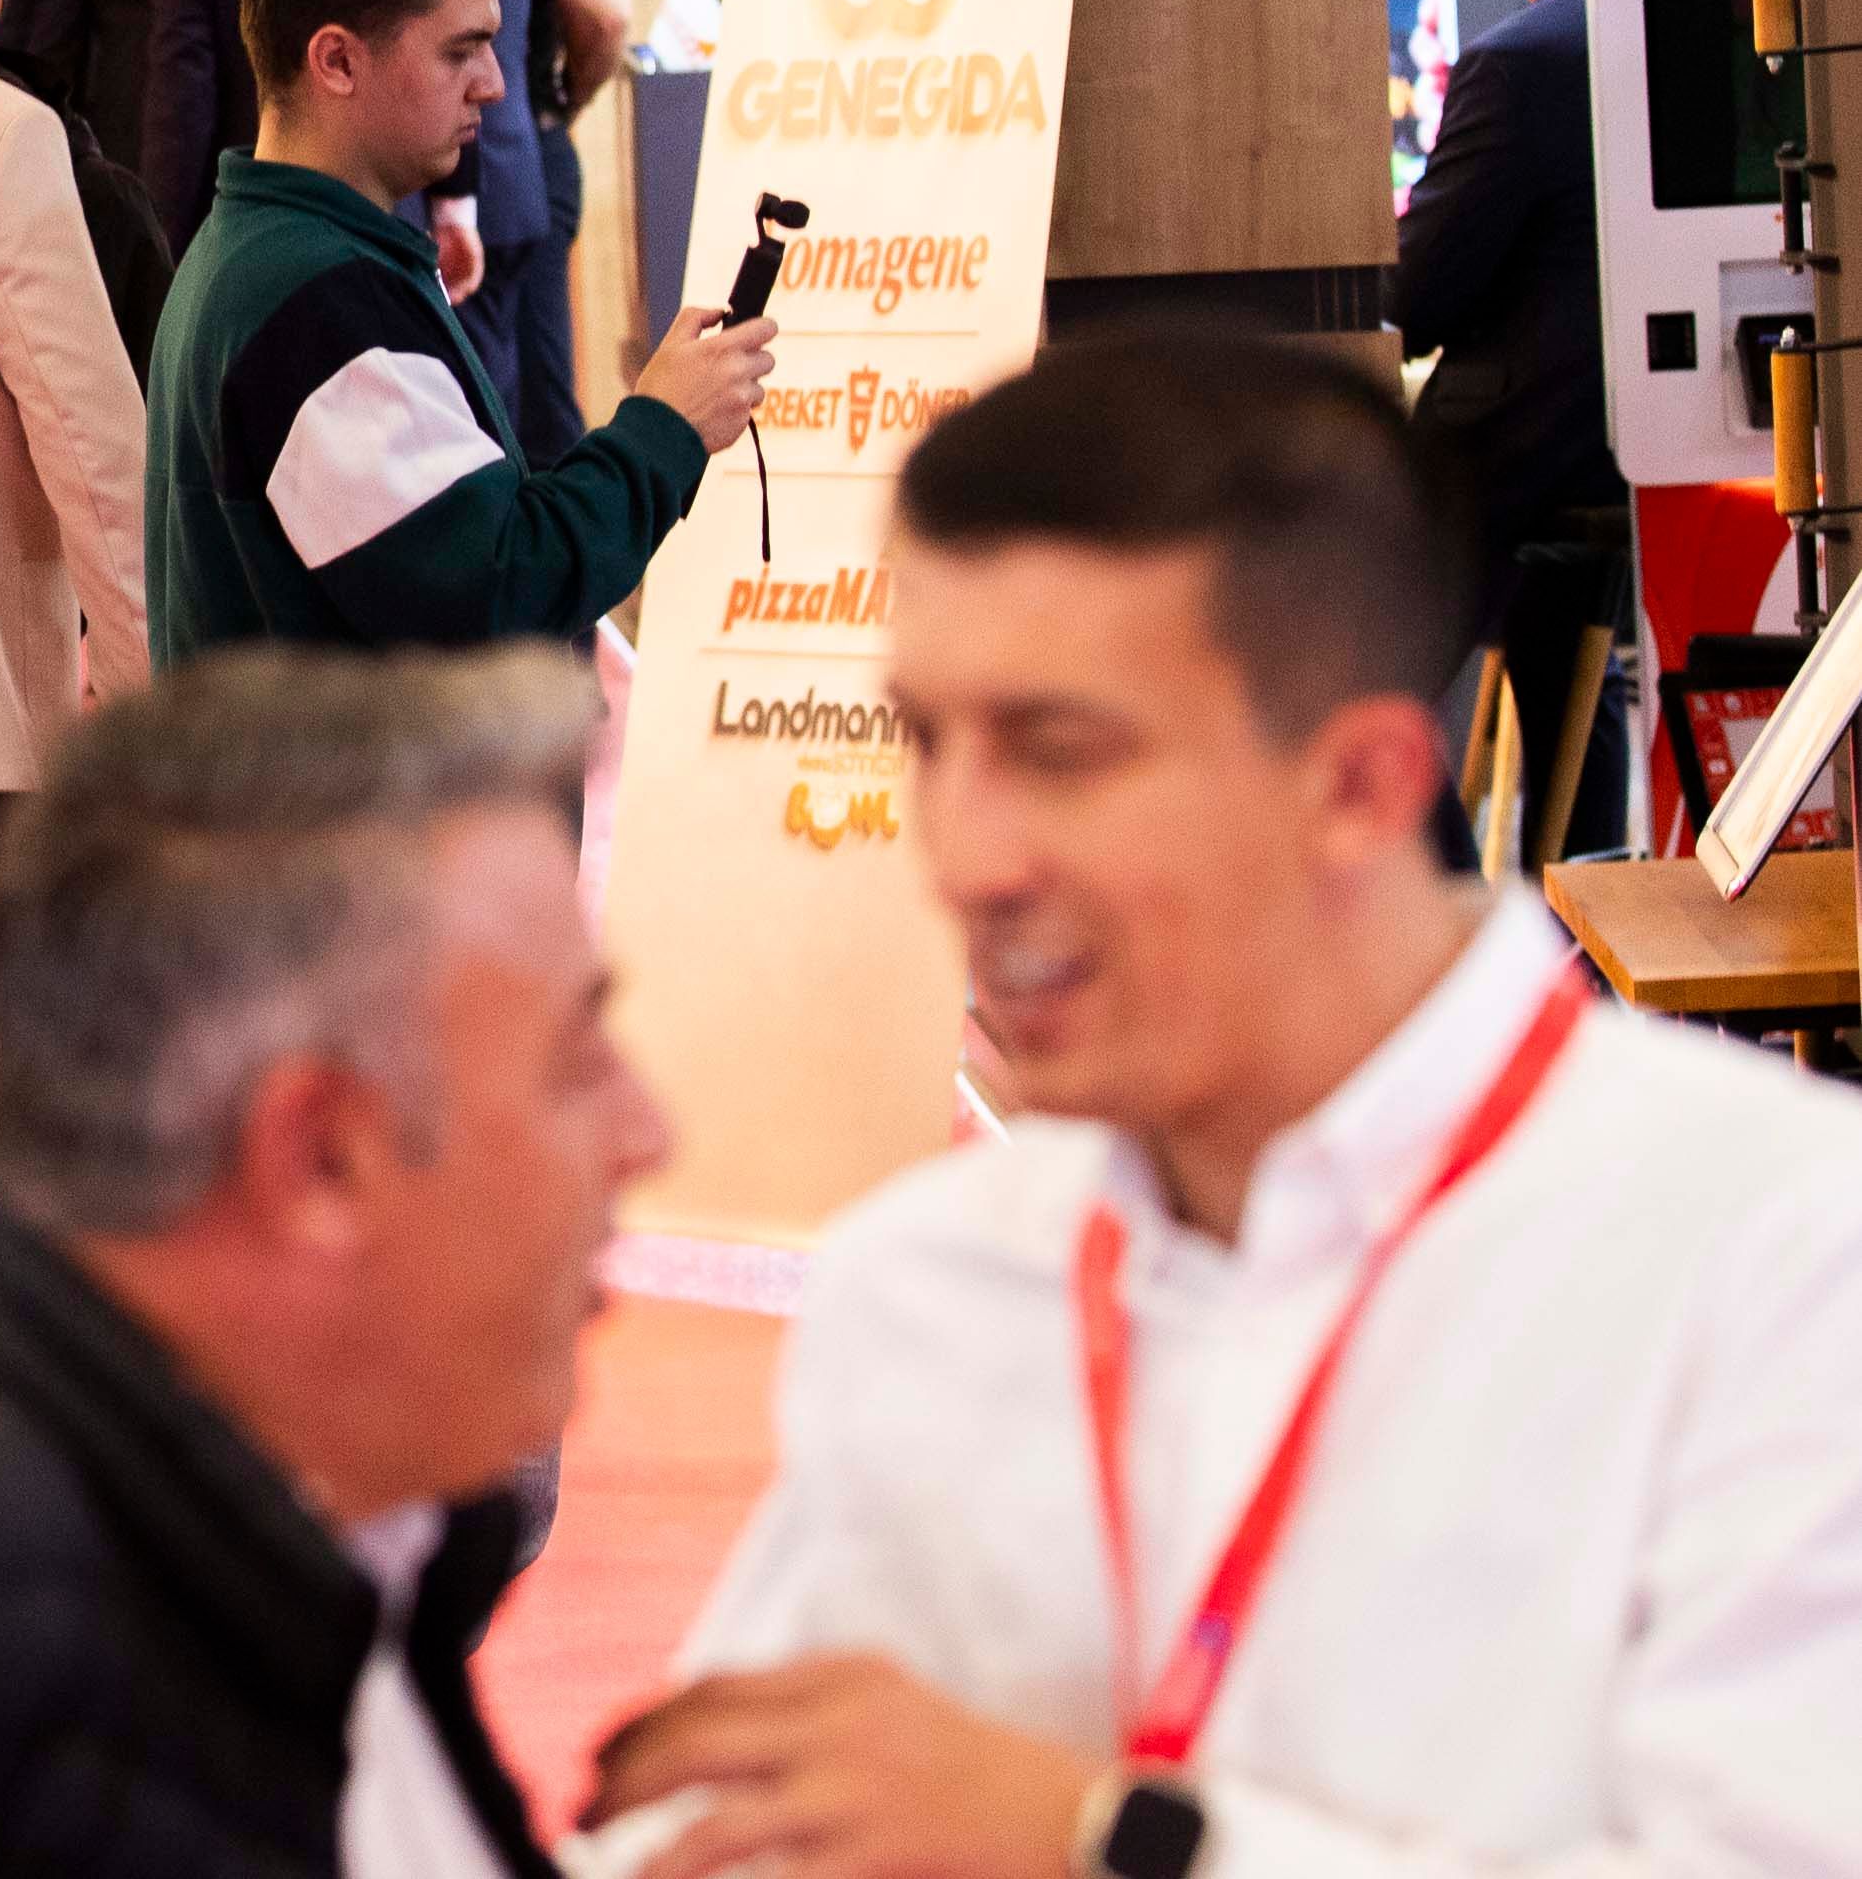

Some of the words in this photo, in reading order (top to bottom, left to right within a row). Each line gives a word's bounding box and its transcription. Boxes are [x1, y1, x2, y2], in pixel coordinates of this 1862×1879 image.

[727, 52, 1046, 140] GENEGIDA
[781, 233, 988, 315] omagene
[756, 388, 844, 430] REKET
[721, 566, 891, 633] pizzaMA
